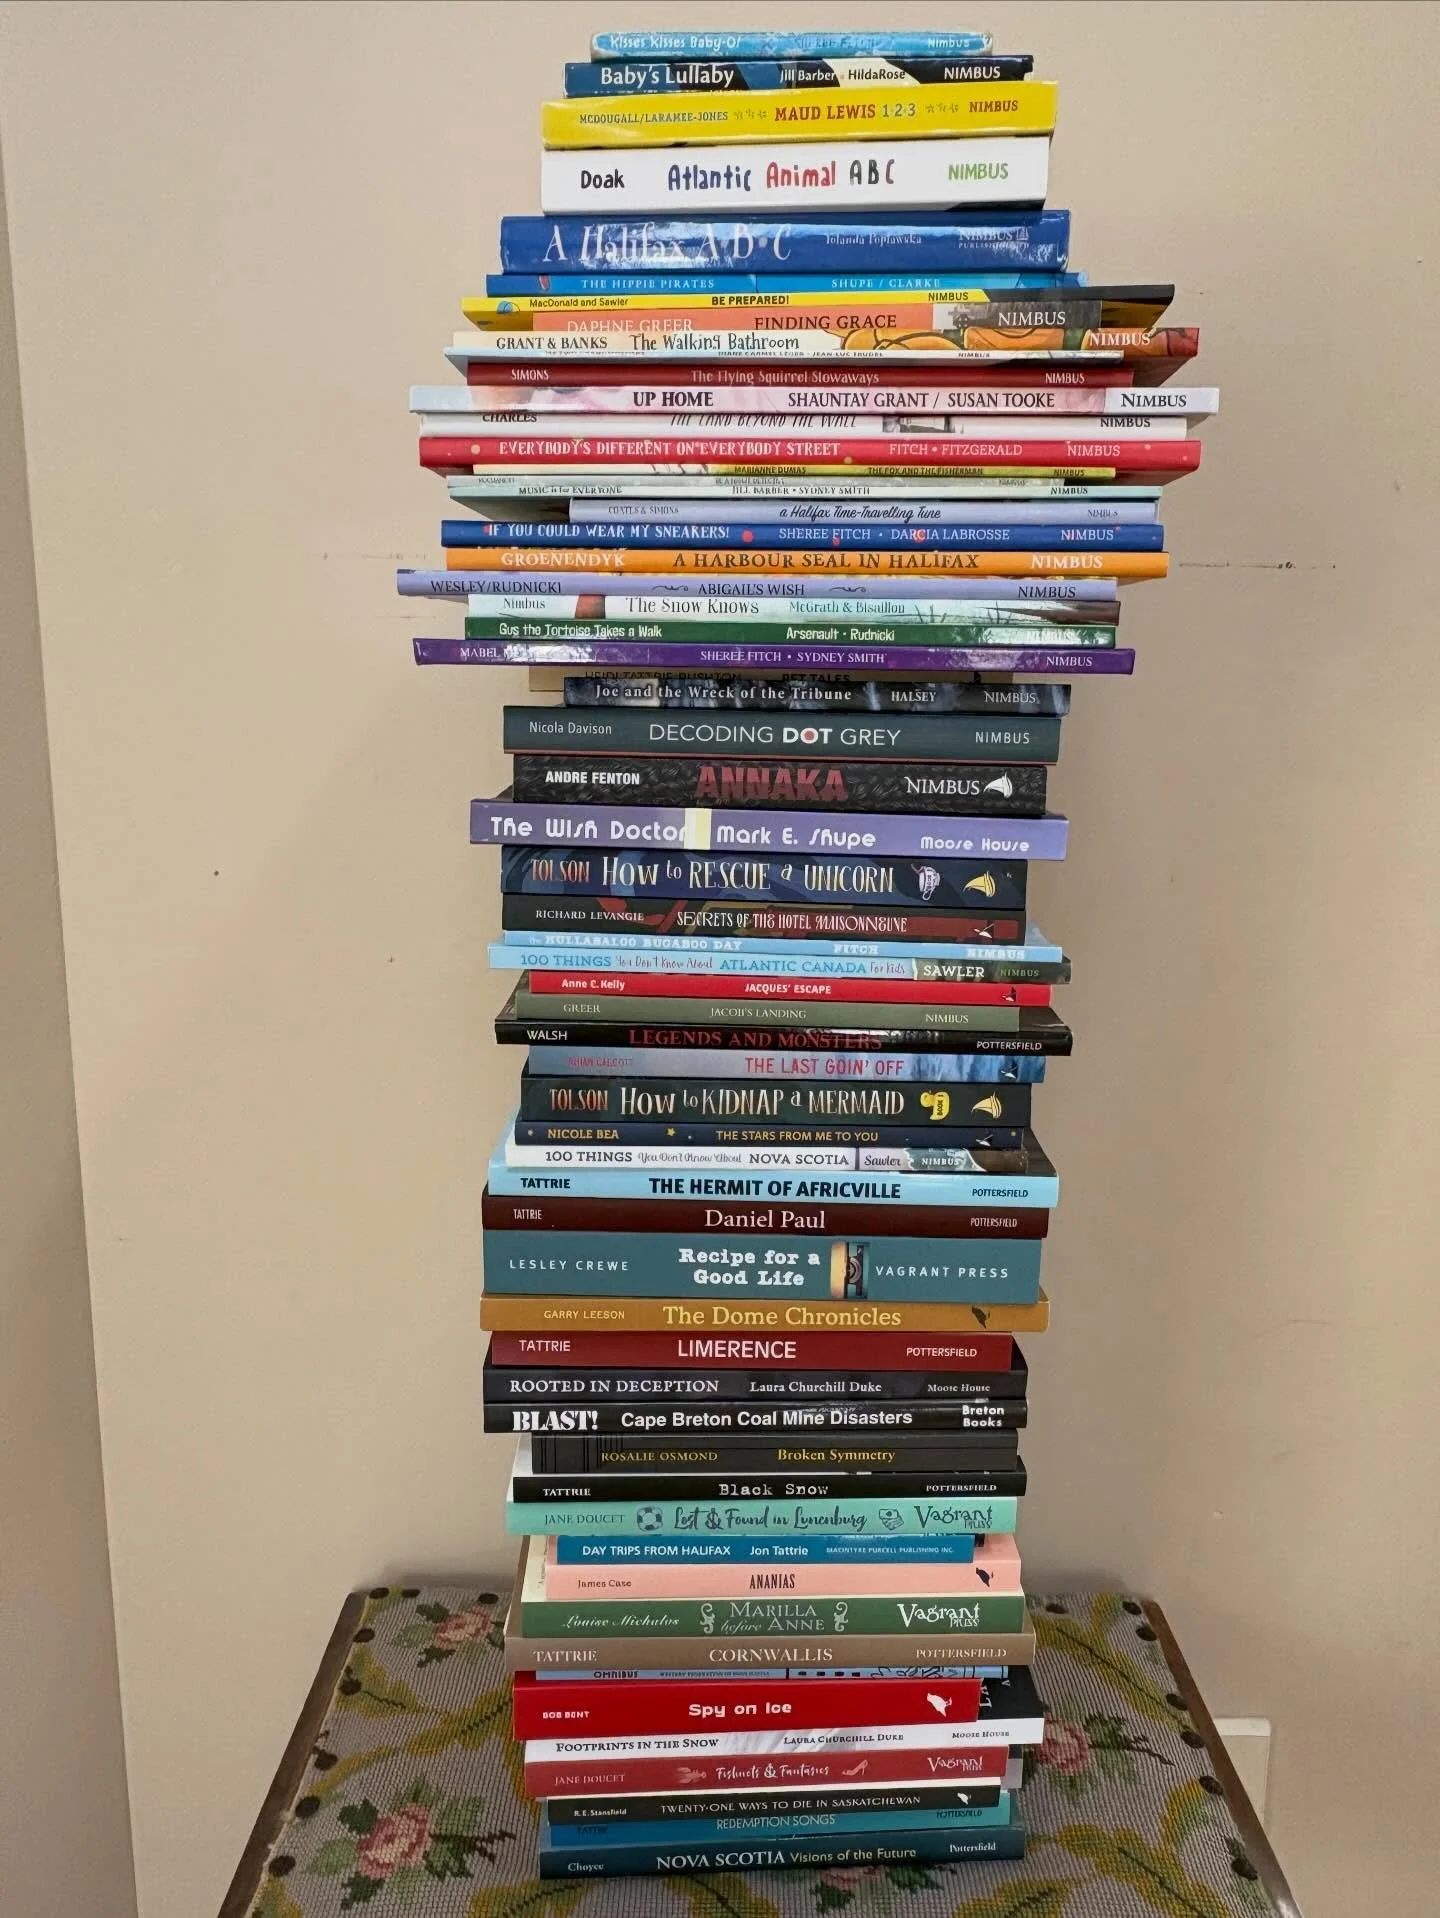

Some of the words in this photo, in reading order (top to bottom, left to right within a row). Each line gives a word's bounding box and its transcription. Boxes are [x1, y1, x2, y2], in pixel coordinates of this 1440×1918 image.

[927, 37, 970, 49] Nimbus
[601, 67, 659, 89] Baby's
[666, 66, 734, 88] Lullaby
[848, 68, 905, 81] HildaRose
[944, 66, 1001, 79] NIMBUS
[969, 100, 1018, 113] NIMBUS
[948, 163, 1009, 181] NIMBUS
[581, 169, 624, 189] Doak
[712, 296, 725, 304] BE
[728, 295, 789, 304] PREPARED!
[928, 291, 968, 301] NIMBUS
[754, 317, 831, 330] FINDING
[836, 314, 896, 329] GRACE
[998, 311, 1066, 328] NIMBUS
[496, 337, 544, 350] GRANT
[548, 337, 557, 349] &
[560, 336, 608, 349] BANKS
[631, 334, 657, 351] The
[663, 333, 721, 351] Walking
[728, 332, 800, 350] Bathroom
[1089, 331, 1151, 346] NIMBUS
[511, 368, 549, 381] SIMONS
[1046, 372, 1085, 384] NIMBUS
[633, 392, 656, 408] UP
[662, 392, 713, 407] HOME
[1121, 393, 1187, 408] NIMBUS
[889, 444, 928, 457] FITCH
[941, 443, 1023, 456] FITZGERALD
[1067, 443, 1121, 457] NIMBUS
[1053, 469, 1085, 477] NIMBUS
[1051, 487, 1088, 495] NIMBUS
[779, 529, 828, 541] SHEREE
[834, 529, 871, 541] FITCH
[891, 529, 939, 541] DARCIA
[943, 529, 1010, 541] LABROSSE
[1061, 529, 1114, 541] NIMBUS
[501, 552, 625, 567] GROENENDYK
[673, 553, 687, 567] A
[694, 553, 792, 568] HARBOUR
[801, 553, 851, 568] SEAL
[859, 554, 880, 568] IN
[888, 554, 980, 568] HALIFAX
[1032, 554, 1103, 568] NIMBUS
[1018, 586, 1076, 598] NIMBUS
[503, 598, 545, 610] Nimbus
[625, 597, 656, 613] The
[661, 597, 702, 613] Snow
[708, 598, 759, 614] Knows
[460, 647, 501, 659] MABEL
[700, 649, 744, 661] SHEREE
[748, 650, 781, 661] FITCH
[797, 651, 844, 664] SYDNEY
[847, 651, 885, 663] SMITH
[1046, 655, 1093, 668] NIMBUS
[892, 691, 936, 702] HALSEY
[984, 691, 1037, 702] NIMBUS
[529, 722, 564, 734] Nicola
[568, 723, 612, 735] Davison
[649, 724, 773, 743] DECODING
[782, 727, 832, 744] DOT
[840, 728, 901, 745] GREY
[976, 732, 1030, 744] NIMBUS
[545, 771, 588, 784] ANDRE
[591, 772, 640, 785] FENTON
[697, 765, 848, 801] ANNAKA
[904, 777, 980, 796] NIMBUS
[920, 836, 973, 850] Moose
[982, 838, 1029, 852] House
[603, 856, 659, 886] How
[665, 860, 681, 879] to
[690, 861, 770, 890] RESCUE
[781, 864, 792, 880] a
[804, 864, 894, 893] UNICORN
[536, 910, 585, 920] RICHARD
[591, 911, 644, 921] LEVANGIE
[521, 954, 549, 966] 100
[554, 955, 611, 967] THINGS
[720, 960, 793, 973] ATLANTIC
[801, 960, 866, 974] CANADA
[923, 965, 985, 978] SAWLER
[562, 979, 586, 988] Anne
[590, 979, 599, 989] C.
[601, 980, 625, 992] Kelly
[564, 1004, 600, 1013] GREER
[925, 1013, 968, 1023] NIMBUS
[527, 1029, 568, 1041] WALSH
[746, 1057, 778, 1073] THE
[782, 1059, 817, 1074] LAST
[825, 1059, 868, 1075] GOIN'
[875, 1060, 904, 1075] OFF
[716, 1131, 739, 1140] THE
[742, 1130, 776, 1141] STARS
[780, 1131, 811, 1141] FROM
[815, 1132, 832, 1141] ME
[835, 1132, 851, 1141] TO
[854, 1131, 878, 1141] YOU
[520, 1178, 570, 1189] TATTRIE
[649, 1178, 686, 1194] THE
[691, 1179, 763, 1196] HERMIT
[767, 1180, 792, 1196] OF
[795, 1182, 900, 1199] AFRICVILLE
[704, 1210, 774, 1228] Daniel
[780, 1210, 825, 1228] Paul
[510, 1260, 567, 1270] LESLEY
[576, 1260, 629, 1271] CREWE
[544, 1310, 578, 1320] GARRY
[583, 1310, 625, 1320] LEESON
[663, 1307, 705, 1325] The
[712, 1307, 779, 1325] Dome
[786, 1307, 902, 1326] Chronicles
[519, 1340, 571, 1352] TATTRIE
[679, 1341, 796, 1359] LIMERENCE
[906, 1347, 977, 1357] POTTERSFIELD
[509, 1381, 585, 1393] ROOTED
[590, 1380, 610, 1392] IN
[617, 1380, 721, 1393] DECEPTION
[962, 1405, 1004, 1417] Breton
[512, 1411, 599, 1431] BLAST!
[963, 1417, 1002, 1427] Books
[601, 1452, 655, 1462] ROSALIE
[660, 1451, 718, 1461] OSMOND
[583, 1546, 606, 1556] DAY
[610, 1546, 640, 1556] TRIPS
[645, 1546, 678, 1556] FROM
[682, 1546, 731, 1556] HALIFAX
[750, 1546, 769, 1556] Jon
[772, 1545, 808, 1556] Tattrie
[750, 1574, 795, 1590] ANANIAS
[731, 1602, 817, 1617] MARILLA
[897, 1603, 980, 1627] Vagrant
[720, 1621, 761, 1633] before
[768, 1618, 824, 1632] ANNE
[532, 1650, 597, 1663] TATTRIE
[710, 1648, 833, 1661] CORNWALLIS
[916, 1649, 1007, 1658] POTTERSFIELD
[594, 1670, 639, 1679] OMNIBUS
[688, 1704, 725, 1718] Spy
[734, 1705, 757, 1715] on
[766, 1702, 792, 1714] Ice
[784, 1735, 817, 1745] LAURA
[818, 1733, 875, 1743] CHURCHILL
[877, 1733, 904, 1742] DUKE
[554, 1775, 580, 1786] JANE
[583, 1774, 625, 1785] DOUCET
[716, 1816, 790, 1829] REDEMPTION
[793, 1813, 835, 1826] SONGS
[949, 1842, 996, 1853] Pottersfield
[657, 1854, 709, 1870] NOVA
[715, 1850, 785, 1867] SCOTIA
[568, 1862, 604, 1872] Choyce
